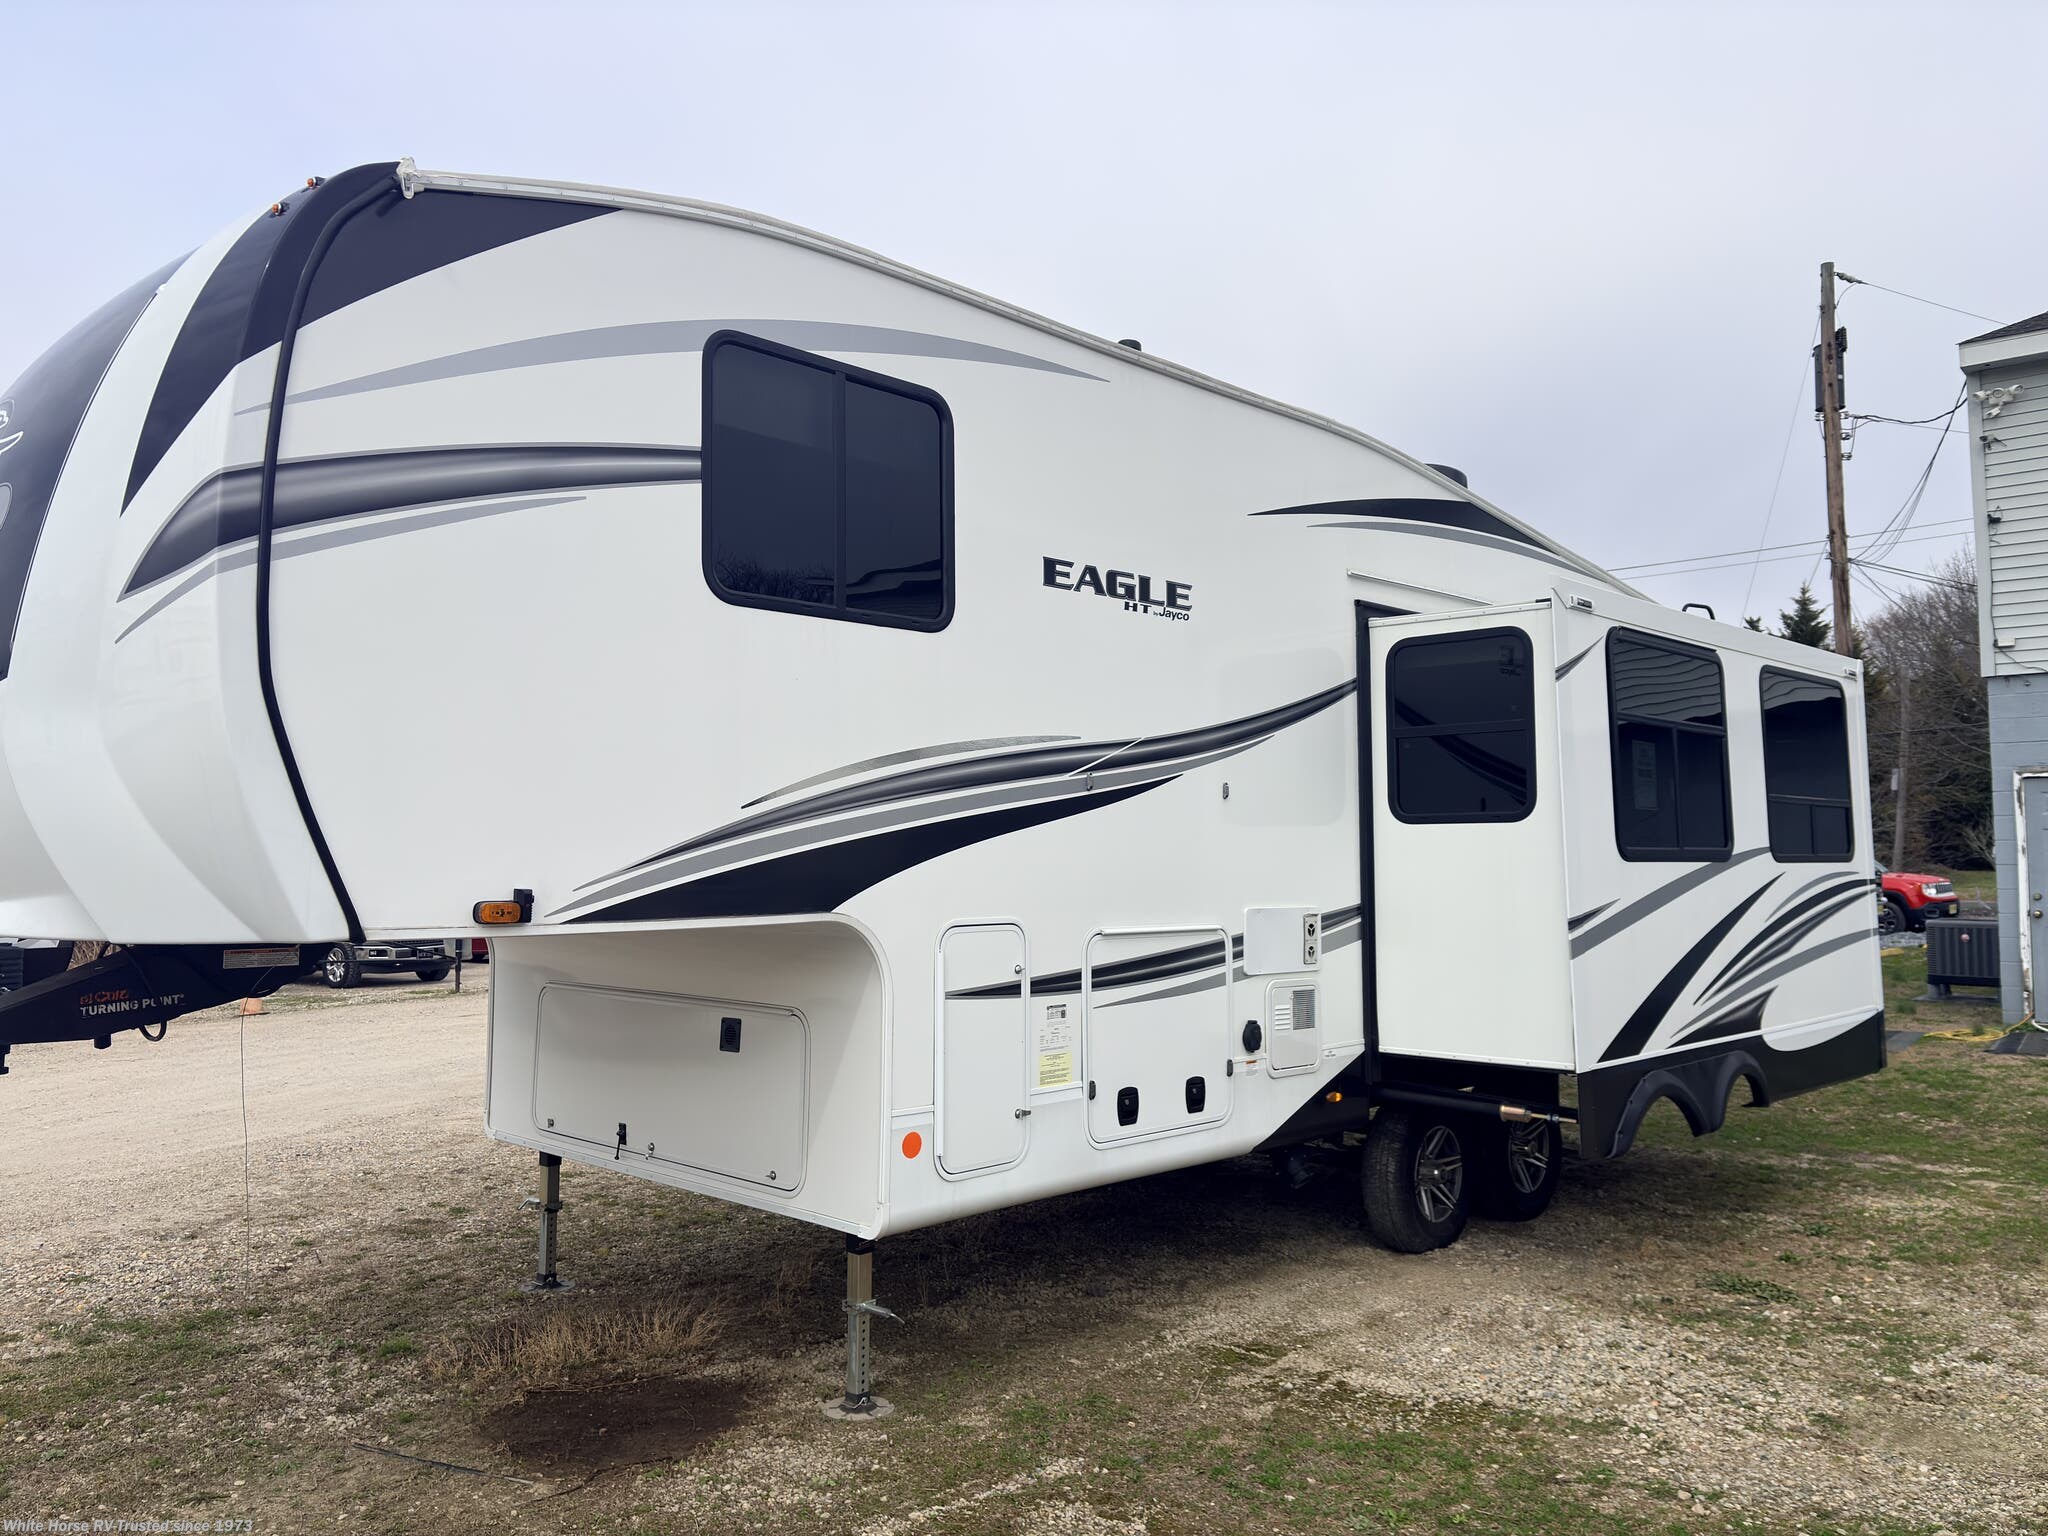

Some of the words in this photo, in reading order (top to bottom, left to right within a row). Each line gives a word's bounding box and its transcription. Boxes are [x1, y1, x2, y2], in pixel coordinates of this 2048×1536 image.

[1042, 556, 1193, 612] EAGLE
[1124, 601, 1152, 614] HT
[1159, 607, 1190, 621] Jayco
[80, 1000, 139, 1017] TURNING
